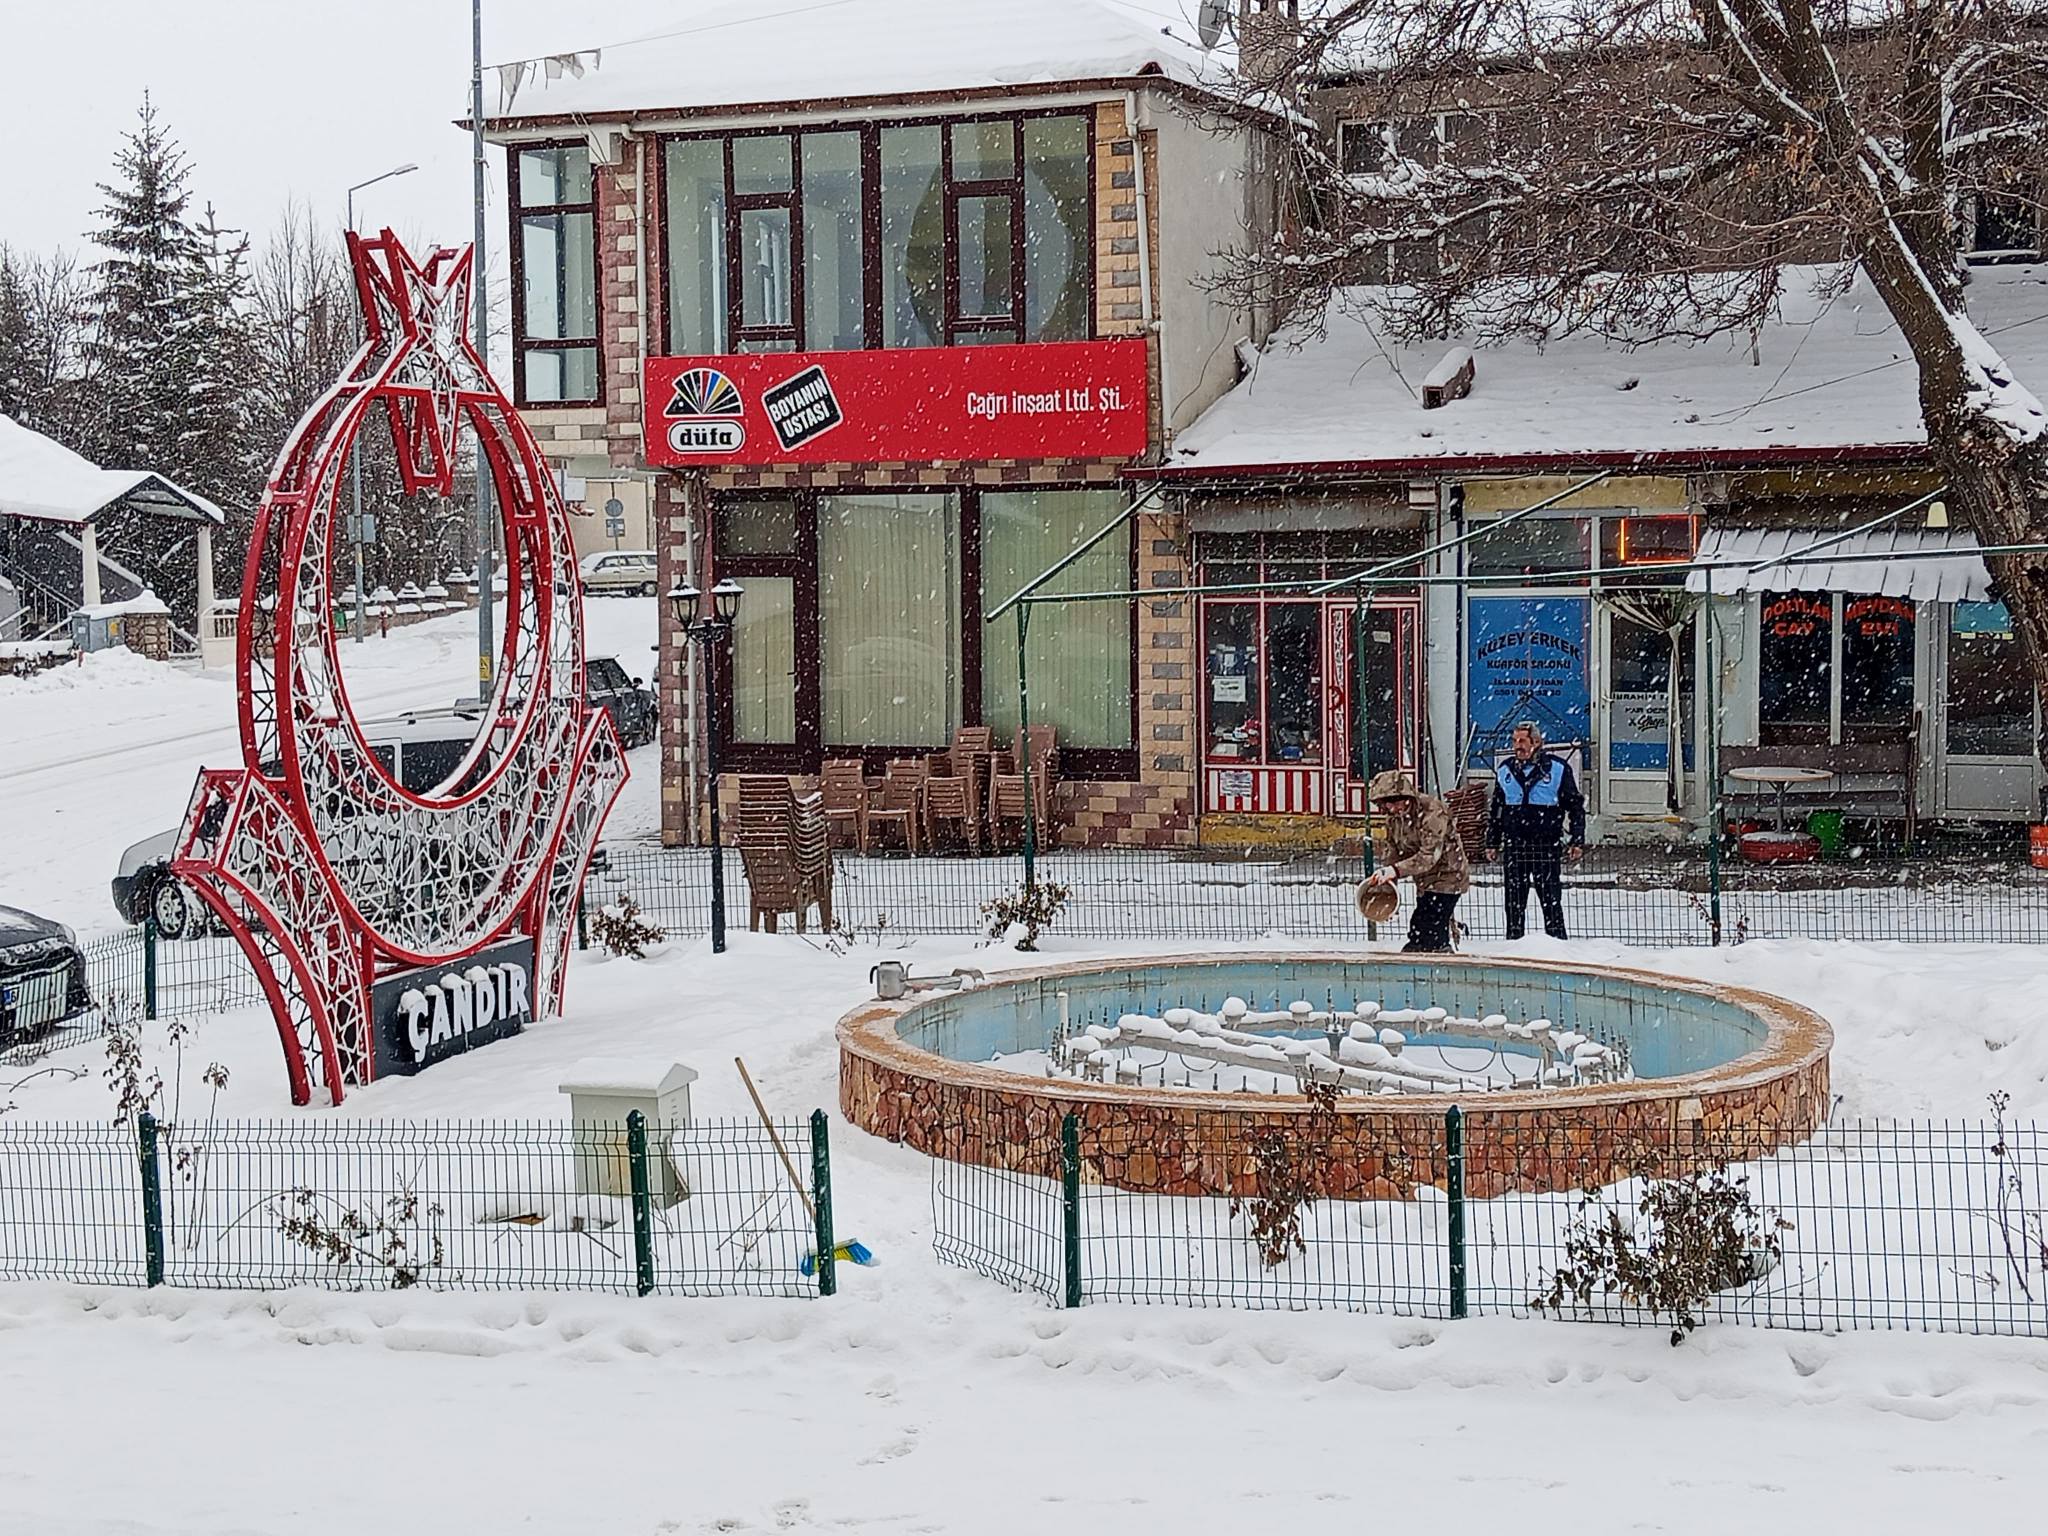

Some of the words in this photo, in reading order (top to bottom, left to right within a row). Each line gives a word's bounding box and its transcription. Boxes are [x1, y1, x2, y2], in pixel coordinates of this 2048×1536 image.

[769, 375, 829, 423] BOYANIN
[967, 391, 1008, 421] Çağrı
[1012, 389, 1062, 417] inşaat
[1065, 386, 1095, 412] Ltd.
[1099, 385, 1125, 415] Şti.
[680, 427, 733, 446] düfa
[782, 400, 831, 439] USTASI
[1476, 632, 1526, 661] KUZEY
[1529, 631, 1581, 662] ERKEK
[405, 965, 530, 1063] ÇANDIR
